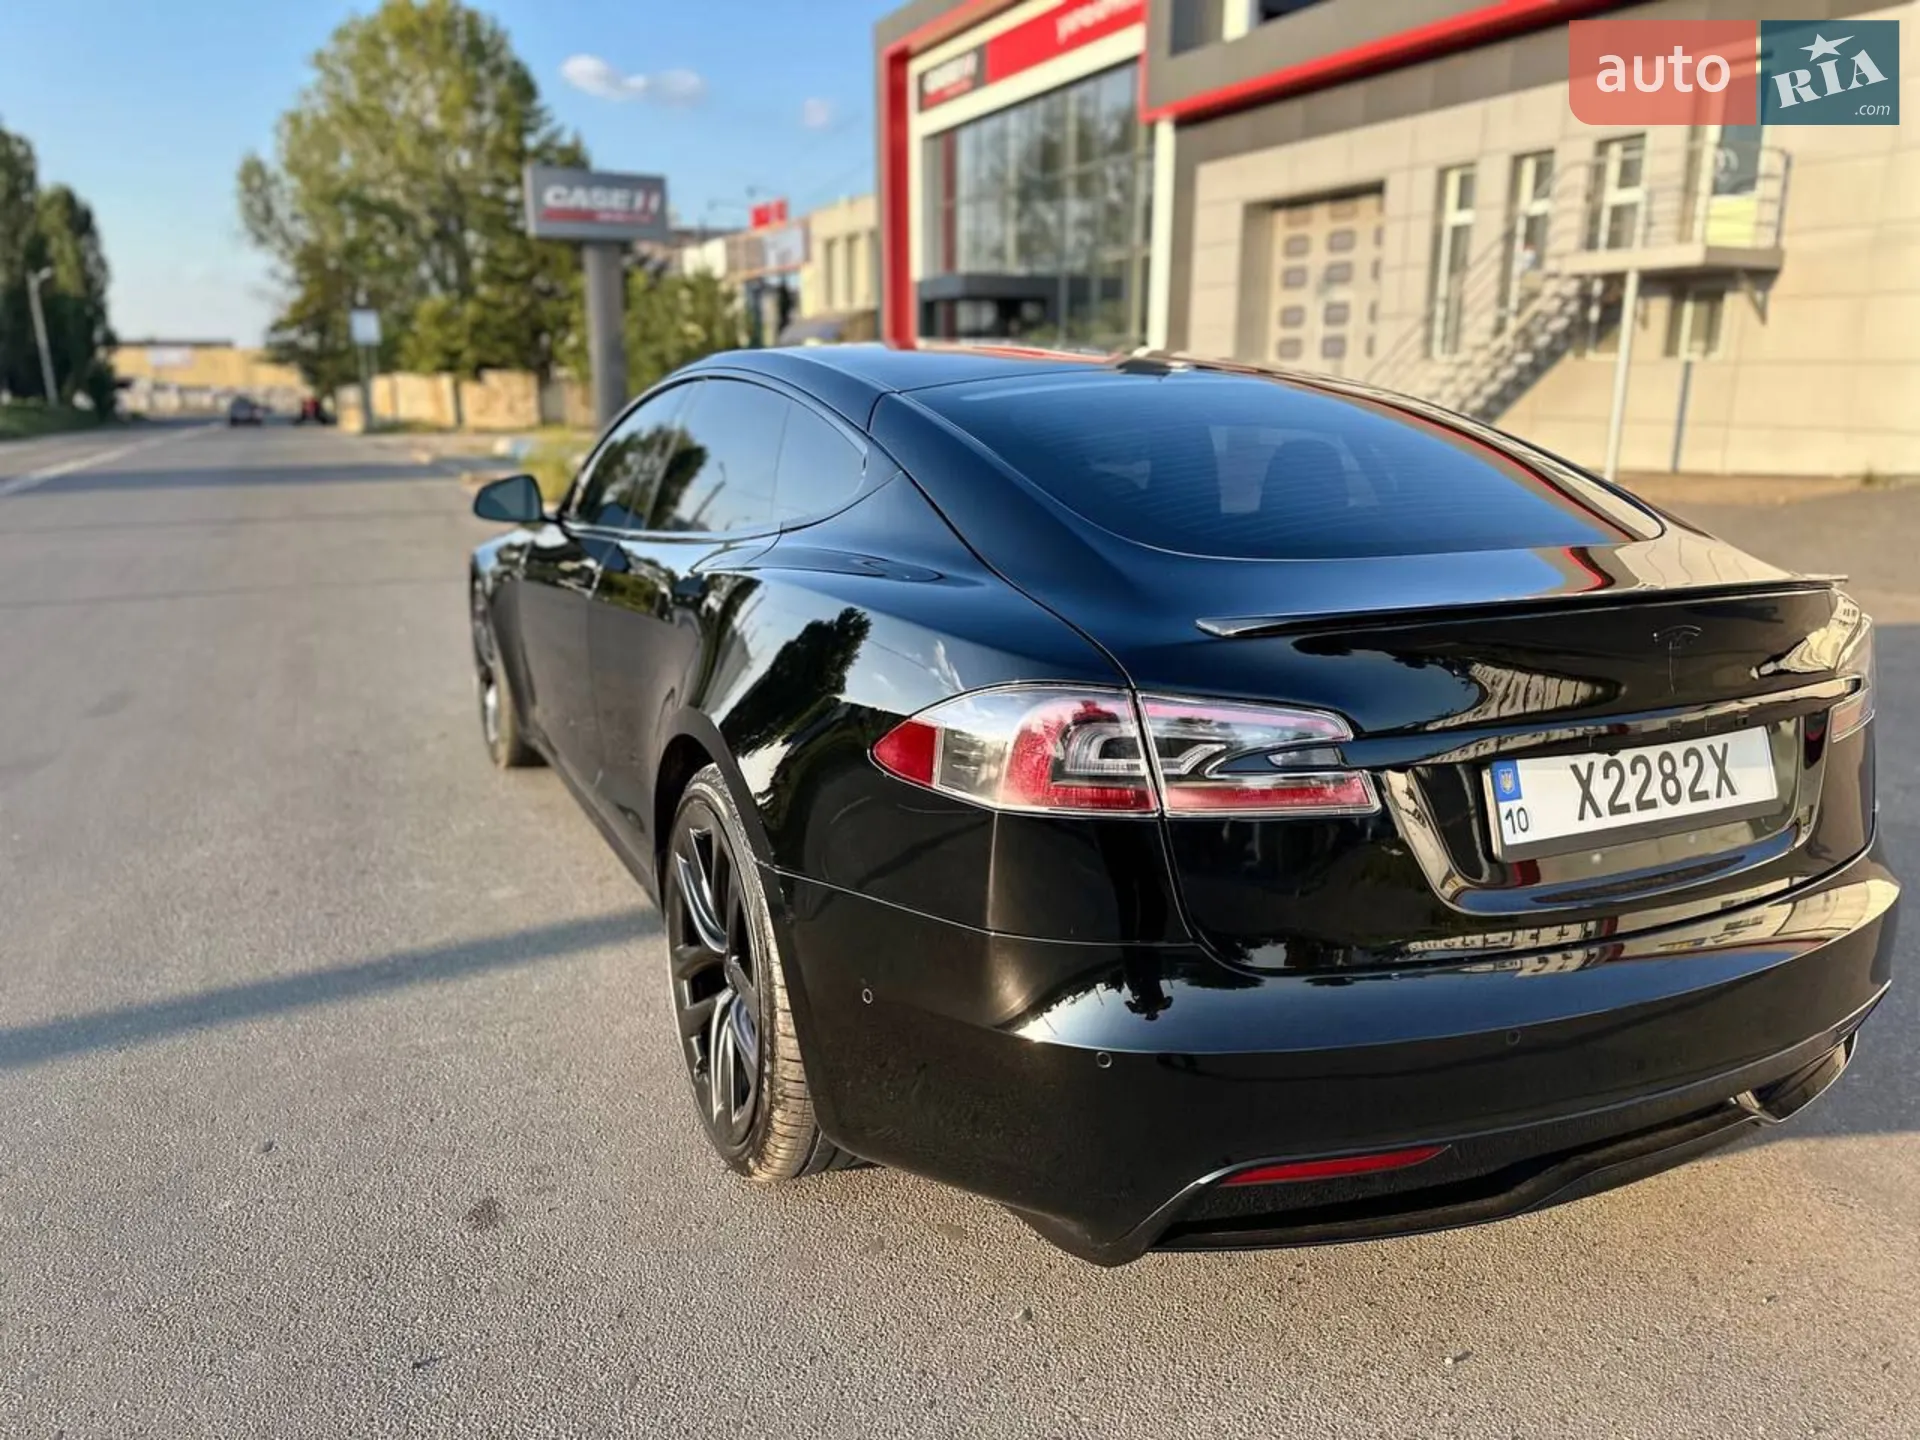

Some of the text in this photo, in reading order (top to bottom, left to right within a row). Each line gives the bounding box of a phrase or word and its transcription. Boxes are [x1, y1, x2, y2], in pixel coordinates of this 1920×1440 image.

[543, 185, 631, 212] CASE
[1570, 742, 1737, 821] X2282X
[1505, 806, 1529, 834] 10
